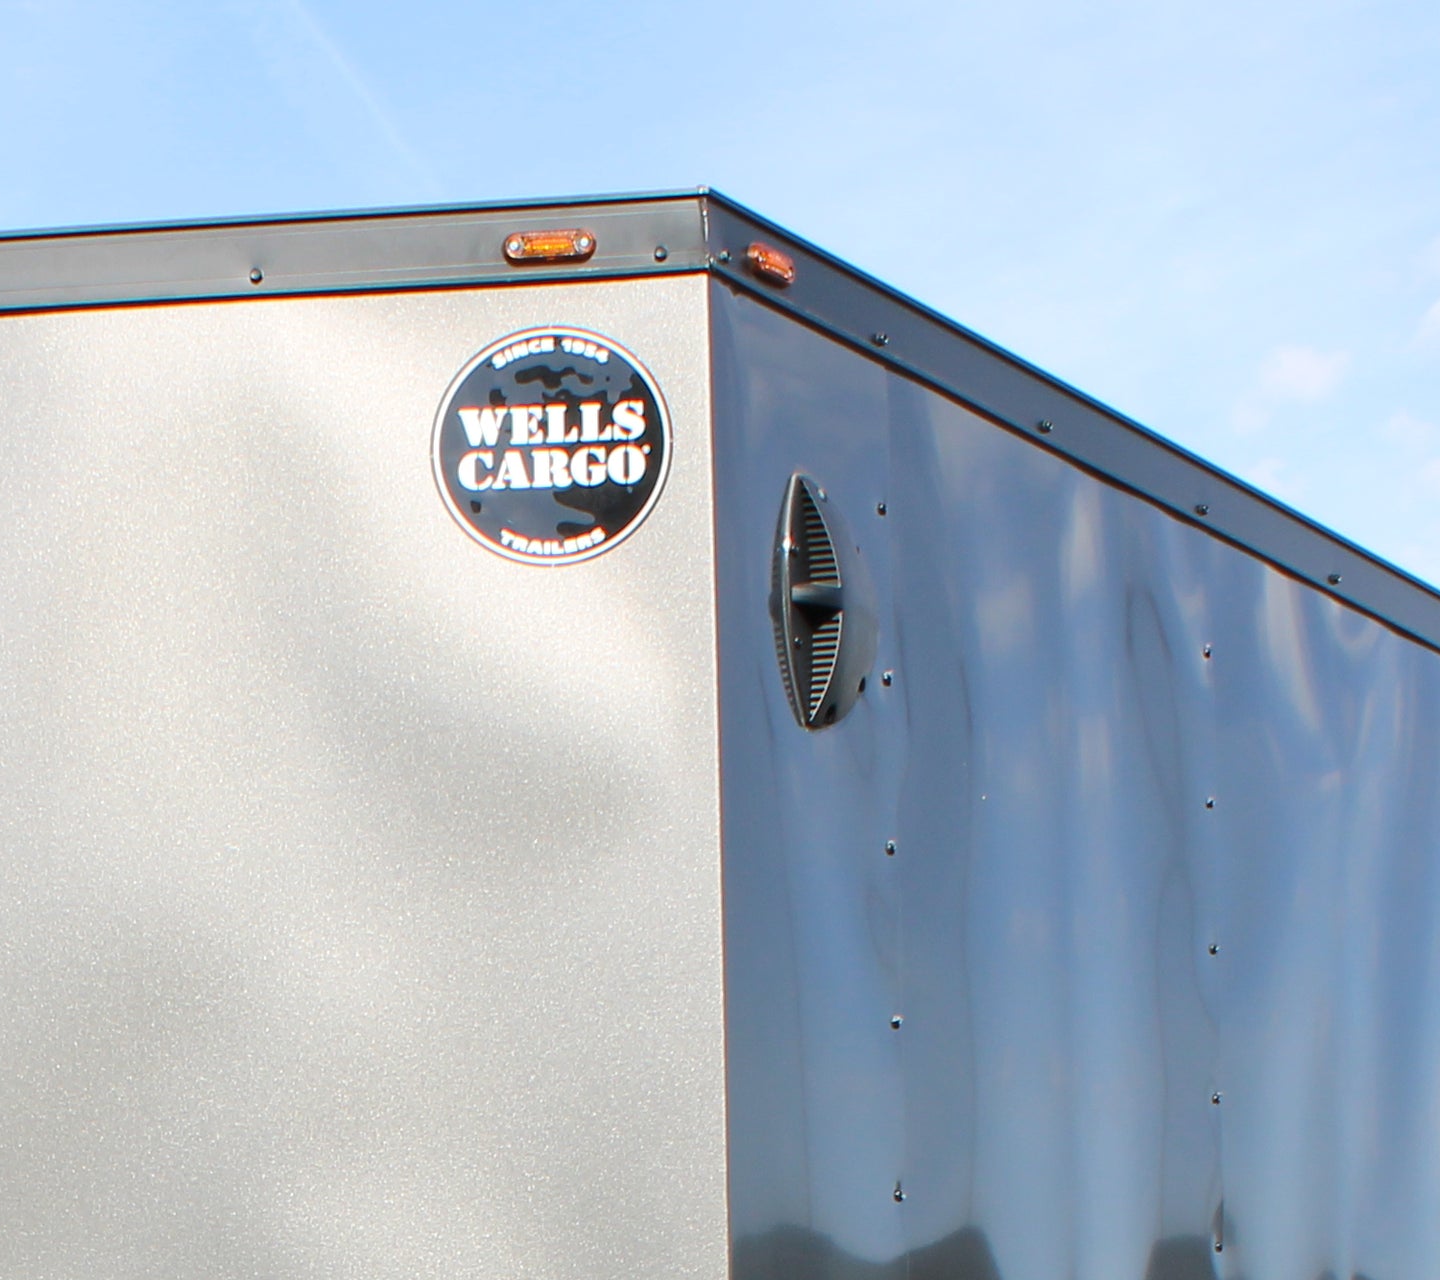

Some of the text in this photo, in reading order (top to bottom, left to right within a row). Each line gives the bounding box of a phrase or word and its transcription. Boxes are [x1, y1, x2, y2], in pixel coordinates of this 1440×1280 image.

[491, 336, 555, 369] SINCE
[457, 400, 646, 447] WELLS
[457, 444, 647, 491] CARGO
[500, 527, 606, 555] TRAILERS
